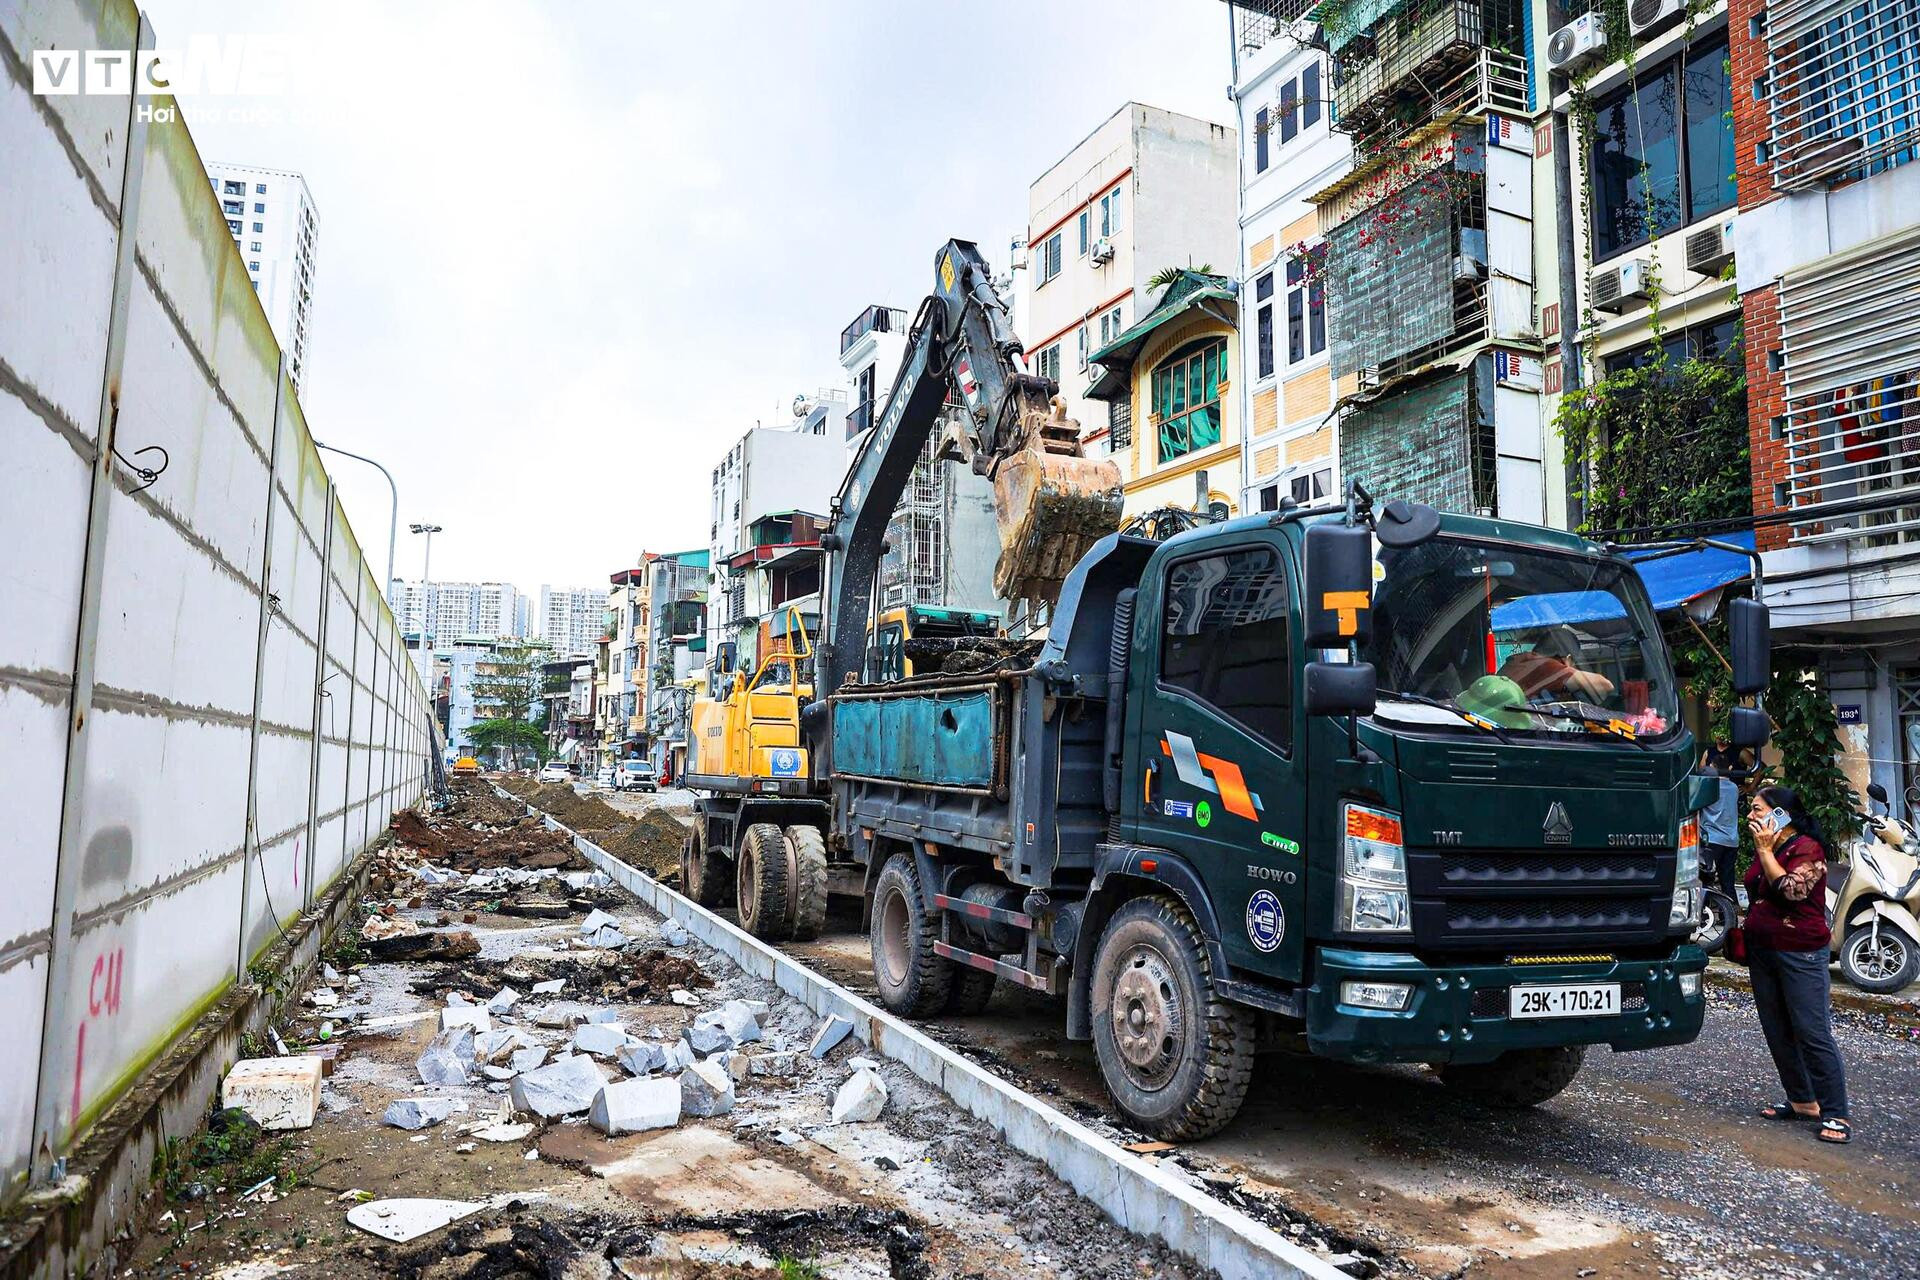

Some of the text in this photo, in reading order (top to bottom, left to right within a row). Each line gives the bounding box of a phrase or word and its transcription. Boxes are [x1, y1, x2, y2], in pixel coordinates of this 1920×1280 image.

[875, 374, 914, 455] VOLVO
[1433, 831, 1463, 845] TMT
[1608, 833, 1667, 846] SINOTRUK
[1247, 864, 1297, 884] HOWO
